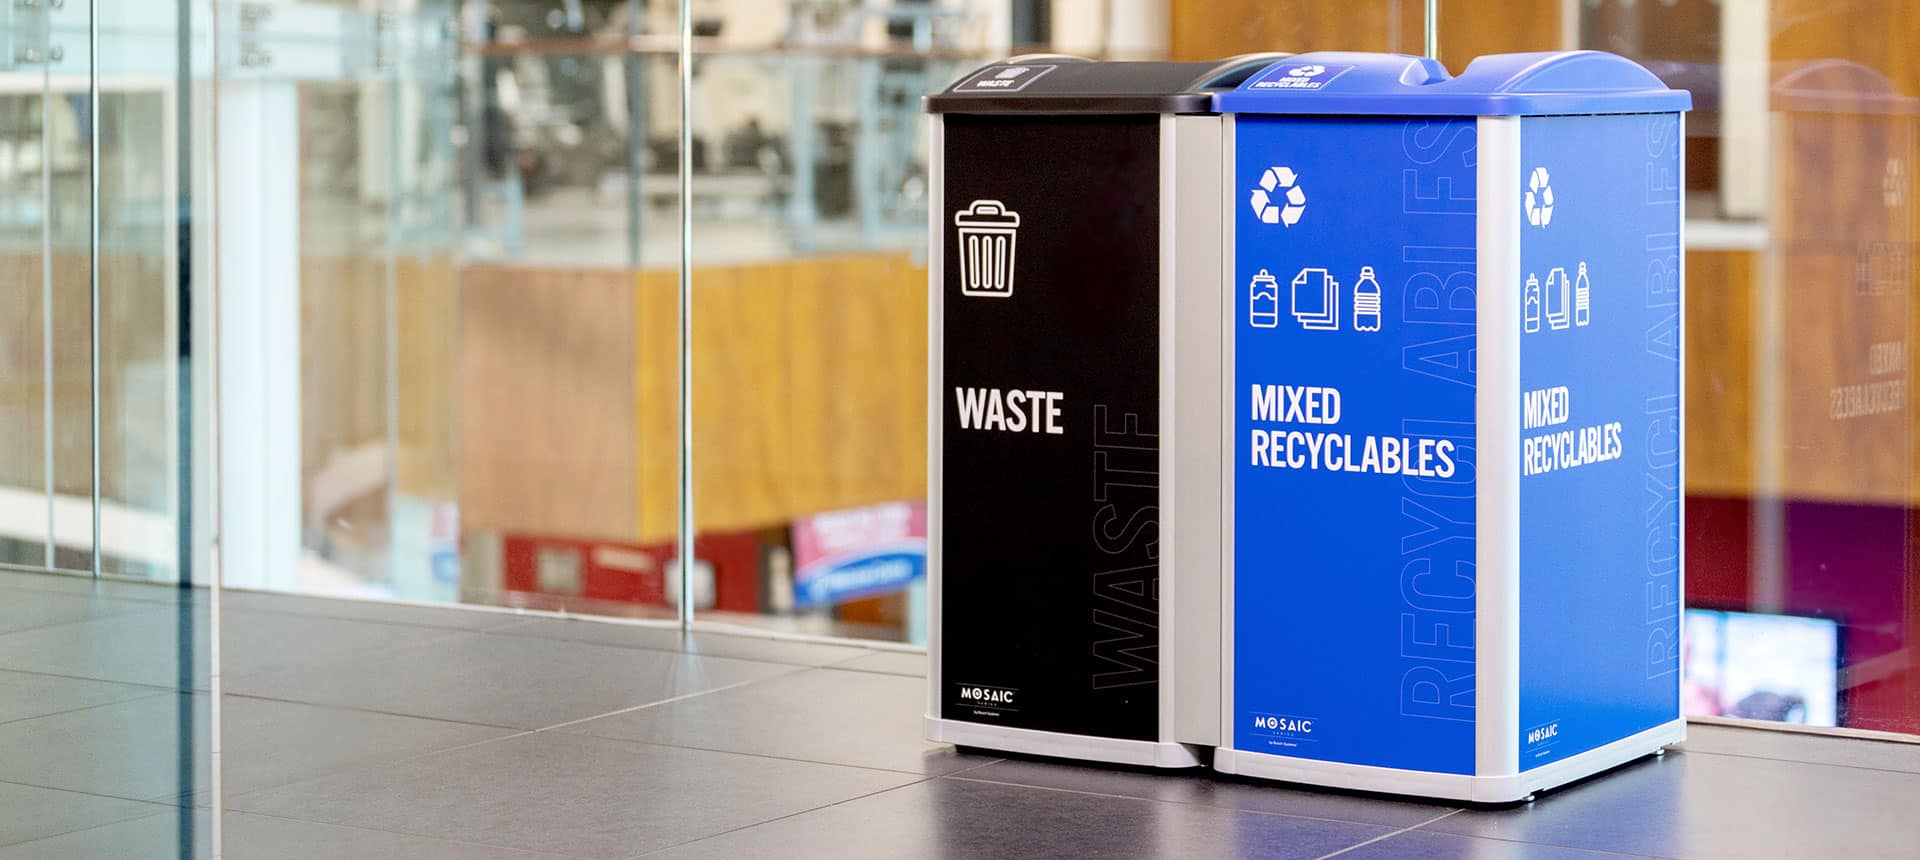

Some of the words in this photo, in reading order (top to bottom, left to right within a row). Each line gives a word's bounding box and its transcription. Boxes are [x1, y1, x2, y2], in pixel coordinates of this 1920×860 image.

[955, 386, 1064, 434] WASTE
[1251, 383, 1341, 425] MIXED
[1524, 386, 1569, 430] MIXED
[1251, 429, 1455, 479] RECYCLABLES
[1524, 421, 1622, 476] RECYCLABLES
[960, 687, 1014, 703] MOSAIC
[1255, 716, 1312, 733] MOSAIC
[1528, 724, 1558, 745] MOSAIC
